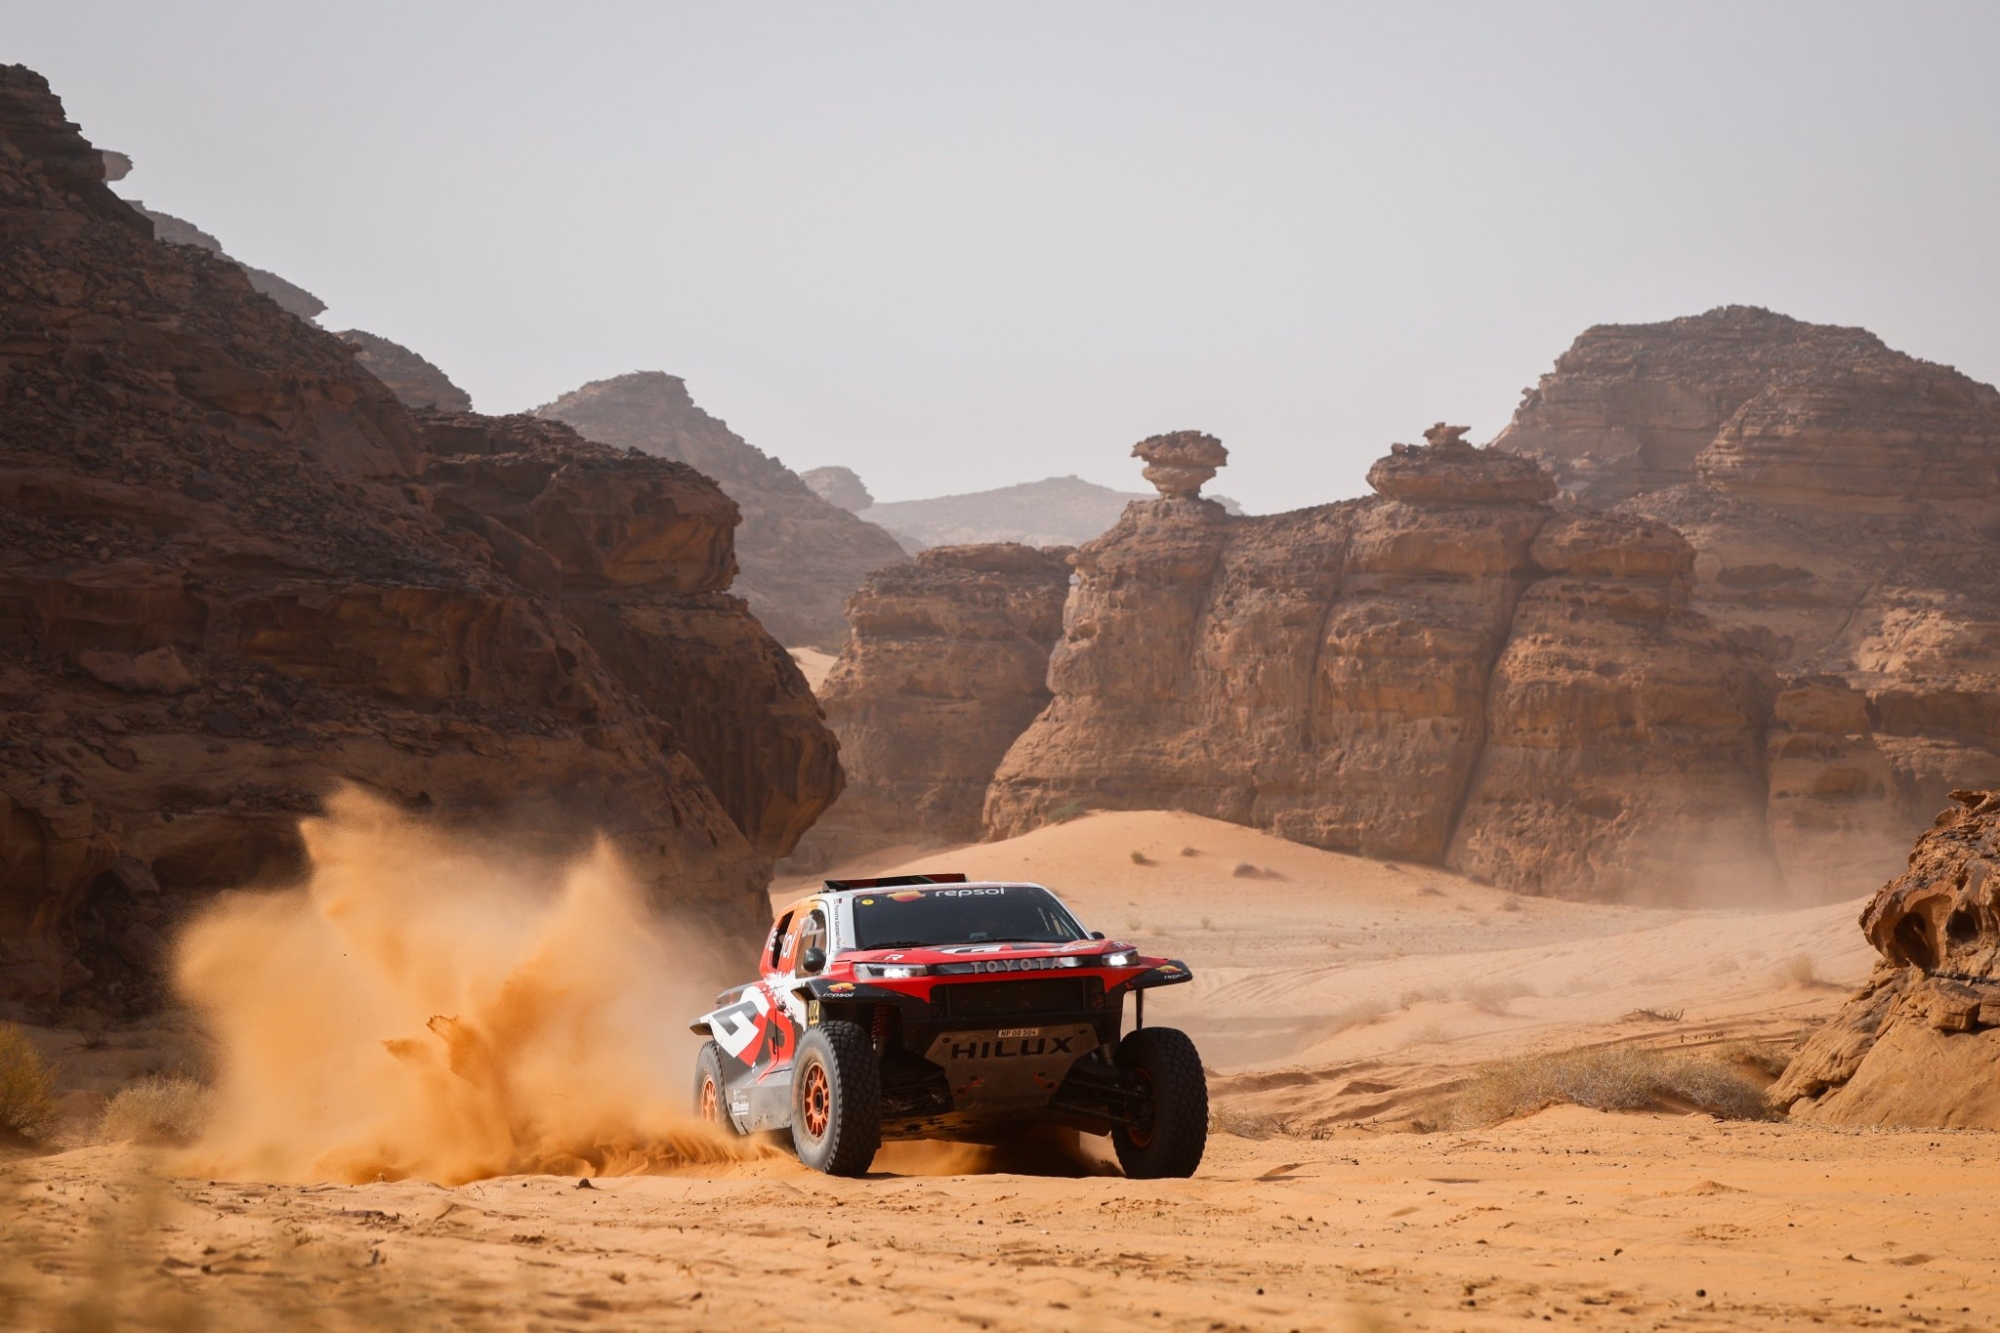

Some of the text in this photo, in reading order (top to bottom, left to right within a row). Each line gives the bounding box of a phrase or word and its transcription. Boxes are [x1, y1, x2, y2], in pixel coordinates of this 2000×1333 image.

[935, 887, 1005, 898] repsol
[970, 957, 1064, 974] TOYOTA
[822, 991, 855, 999] repsol
[950, 1036, 1075, 1060] HILUX
